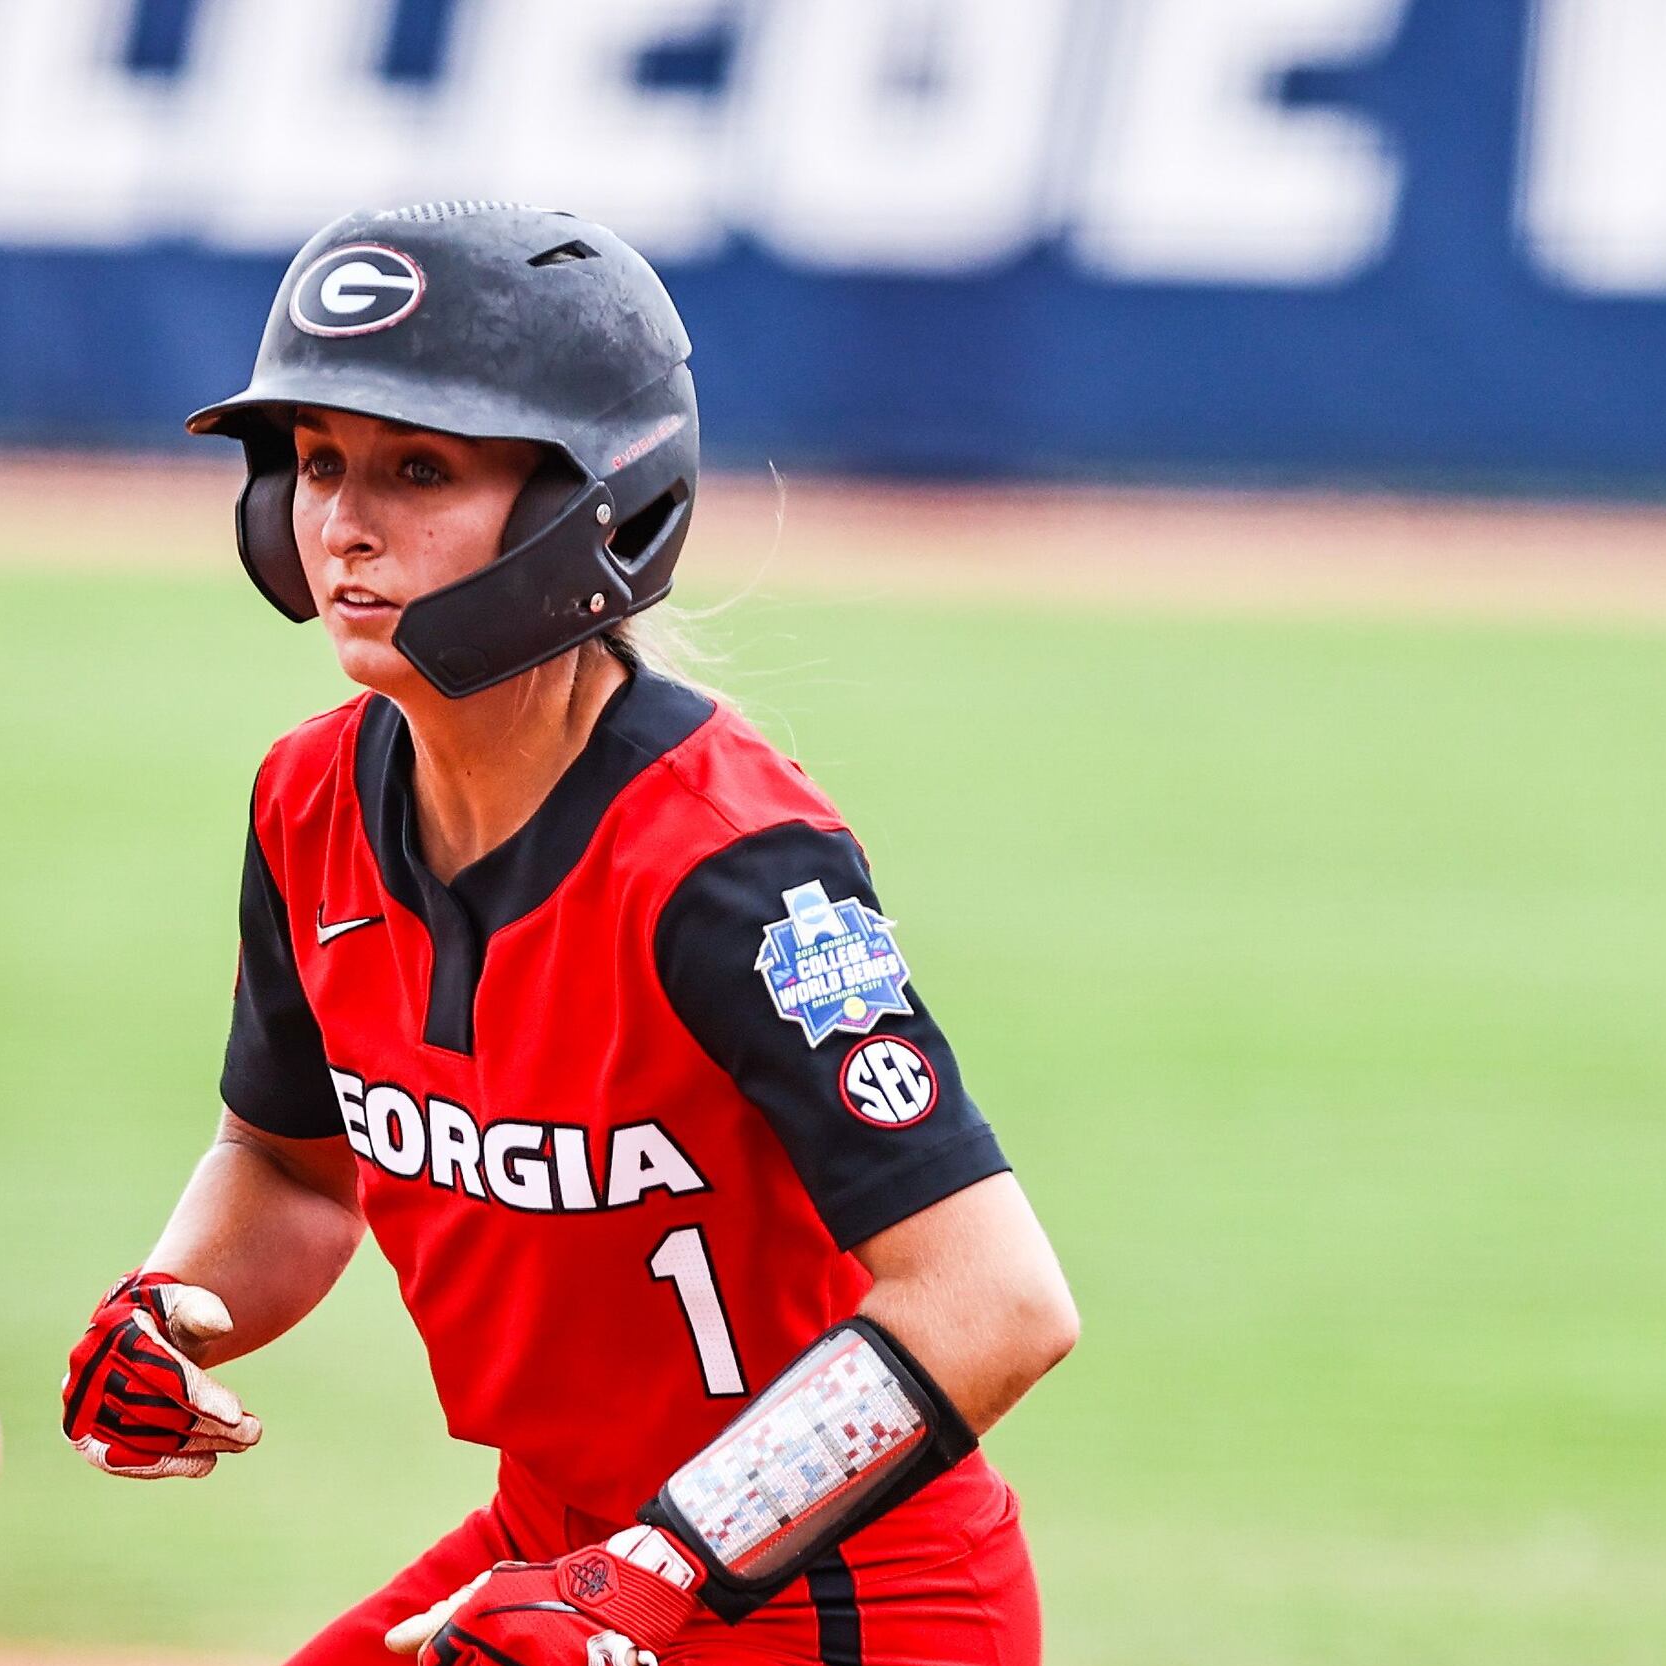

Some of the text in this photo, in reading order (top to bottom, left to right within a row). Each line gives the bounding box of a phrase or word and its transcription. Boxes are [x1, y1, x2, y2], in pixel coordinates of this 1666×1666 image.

[778, 953, 901, 1009] WORLD SERIES
[796, 940, 870, 981] COLLEGE
[845, 1040, 932, 1123] SEC
[646, 1222, 749, 1399] 1
